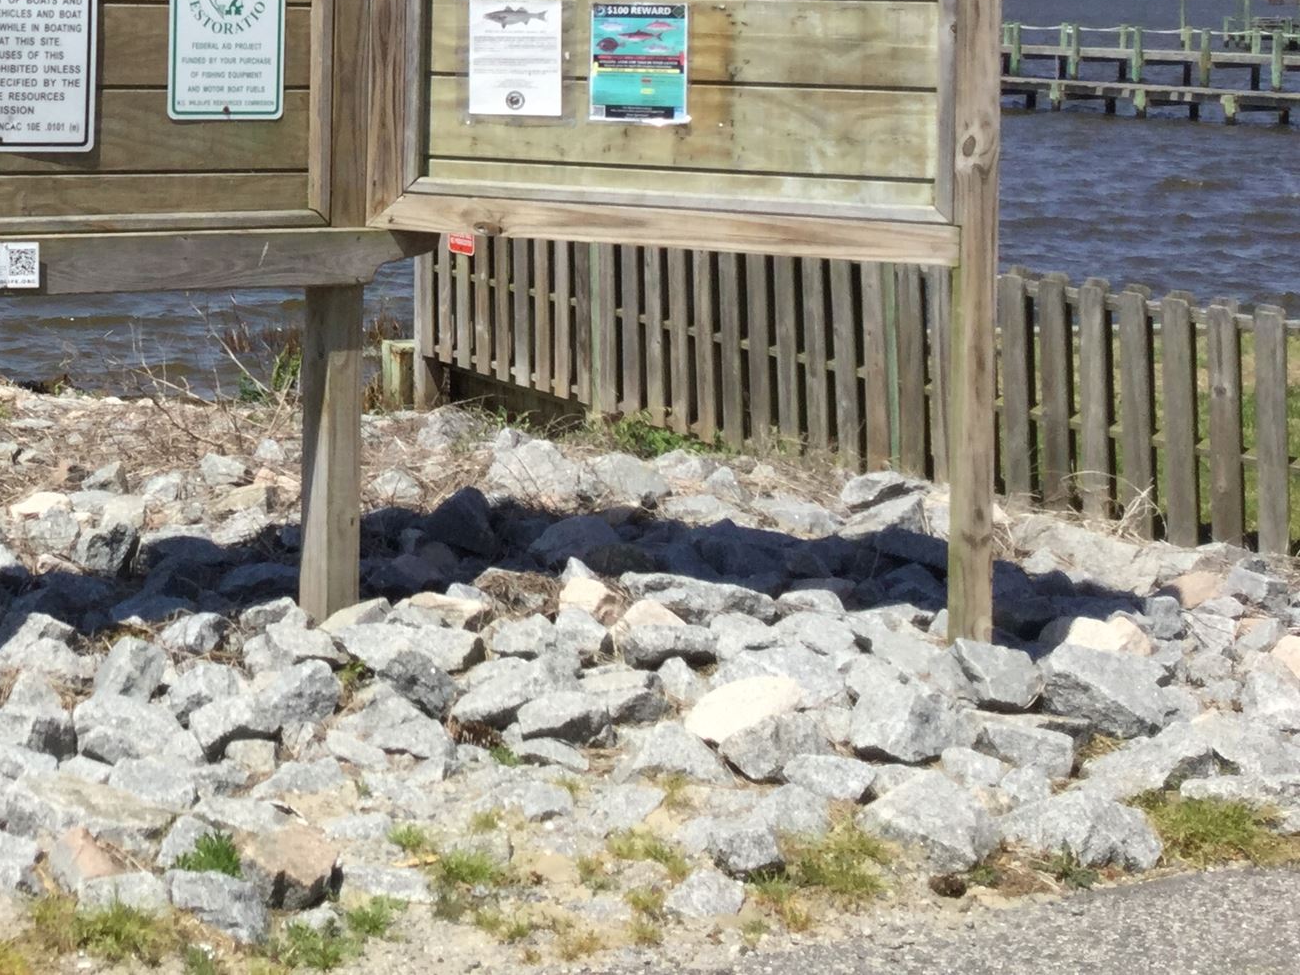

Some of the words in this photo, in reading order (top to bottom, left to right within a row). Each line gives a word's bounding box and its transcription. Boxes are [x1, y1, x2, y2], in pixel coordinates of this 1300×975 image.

[37, 9, 55, 19] AND
[59, 9, 82, 19] BOAT
[607, 6, 629, 16] $100
[631, 6, 671, 15] REWARD
[0, 23, 26, 32] WHILE
[31, 23, 39, 32] IN
[44, 23, 82, 33] BOATING
[0, 37, 10, 46] AT
[15, 37, 35, 46] THIS
[0, 51, 23, 60] USES
[28, 51, 40, 60] OF
[45, 51, 64, 60] THIS
[44, 65, 81, 74] UNLESS
[44, 79, 56, 87] BY
[62, 79, 81, 88] THE
[9, 92, 65, 101] RESOURCES
[0, 123, 22, 131] NCAC
